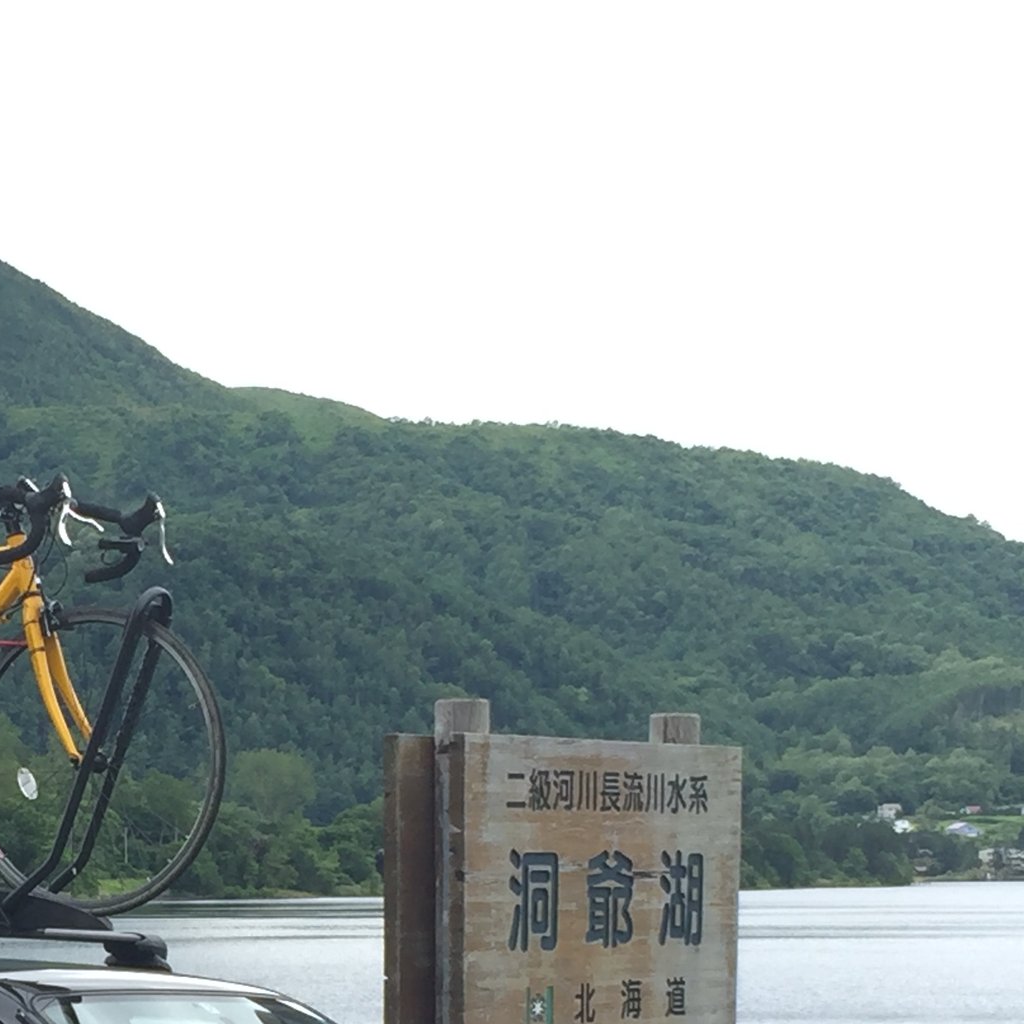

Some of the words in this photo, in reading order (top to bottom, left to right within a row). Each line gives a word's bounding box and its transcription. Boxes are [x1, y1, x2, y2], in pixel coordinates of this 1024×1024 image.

[506, 769, 708, 814] 二級河川長流川水系
[508, 848, 704, 952] 洞爺湖
[574, 976, 686, 1024] 北海道
